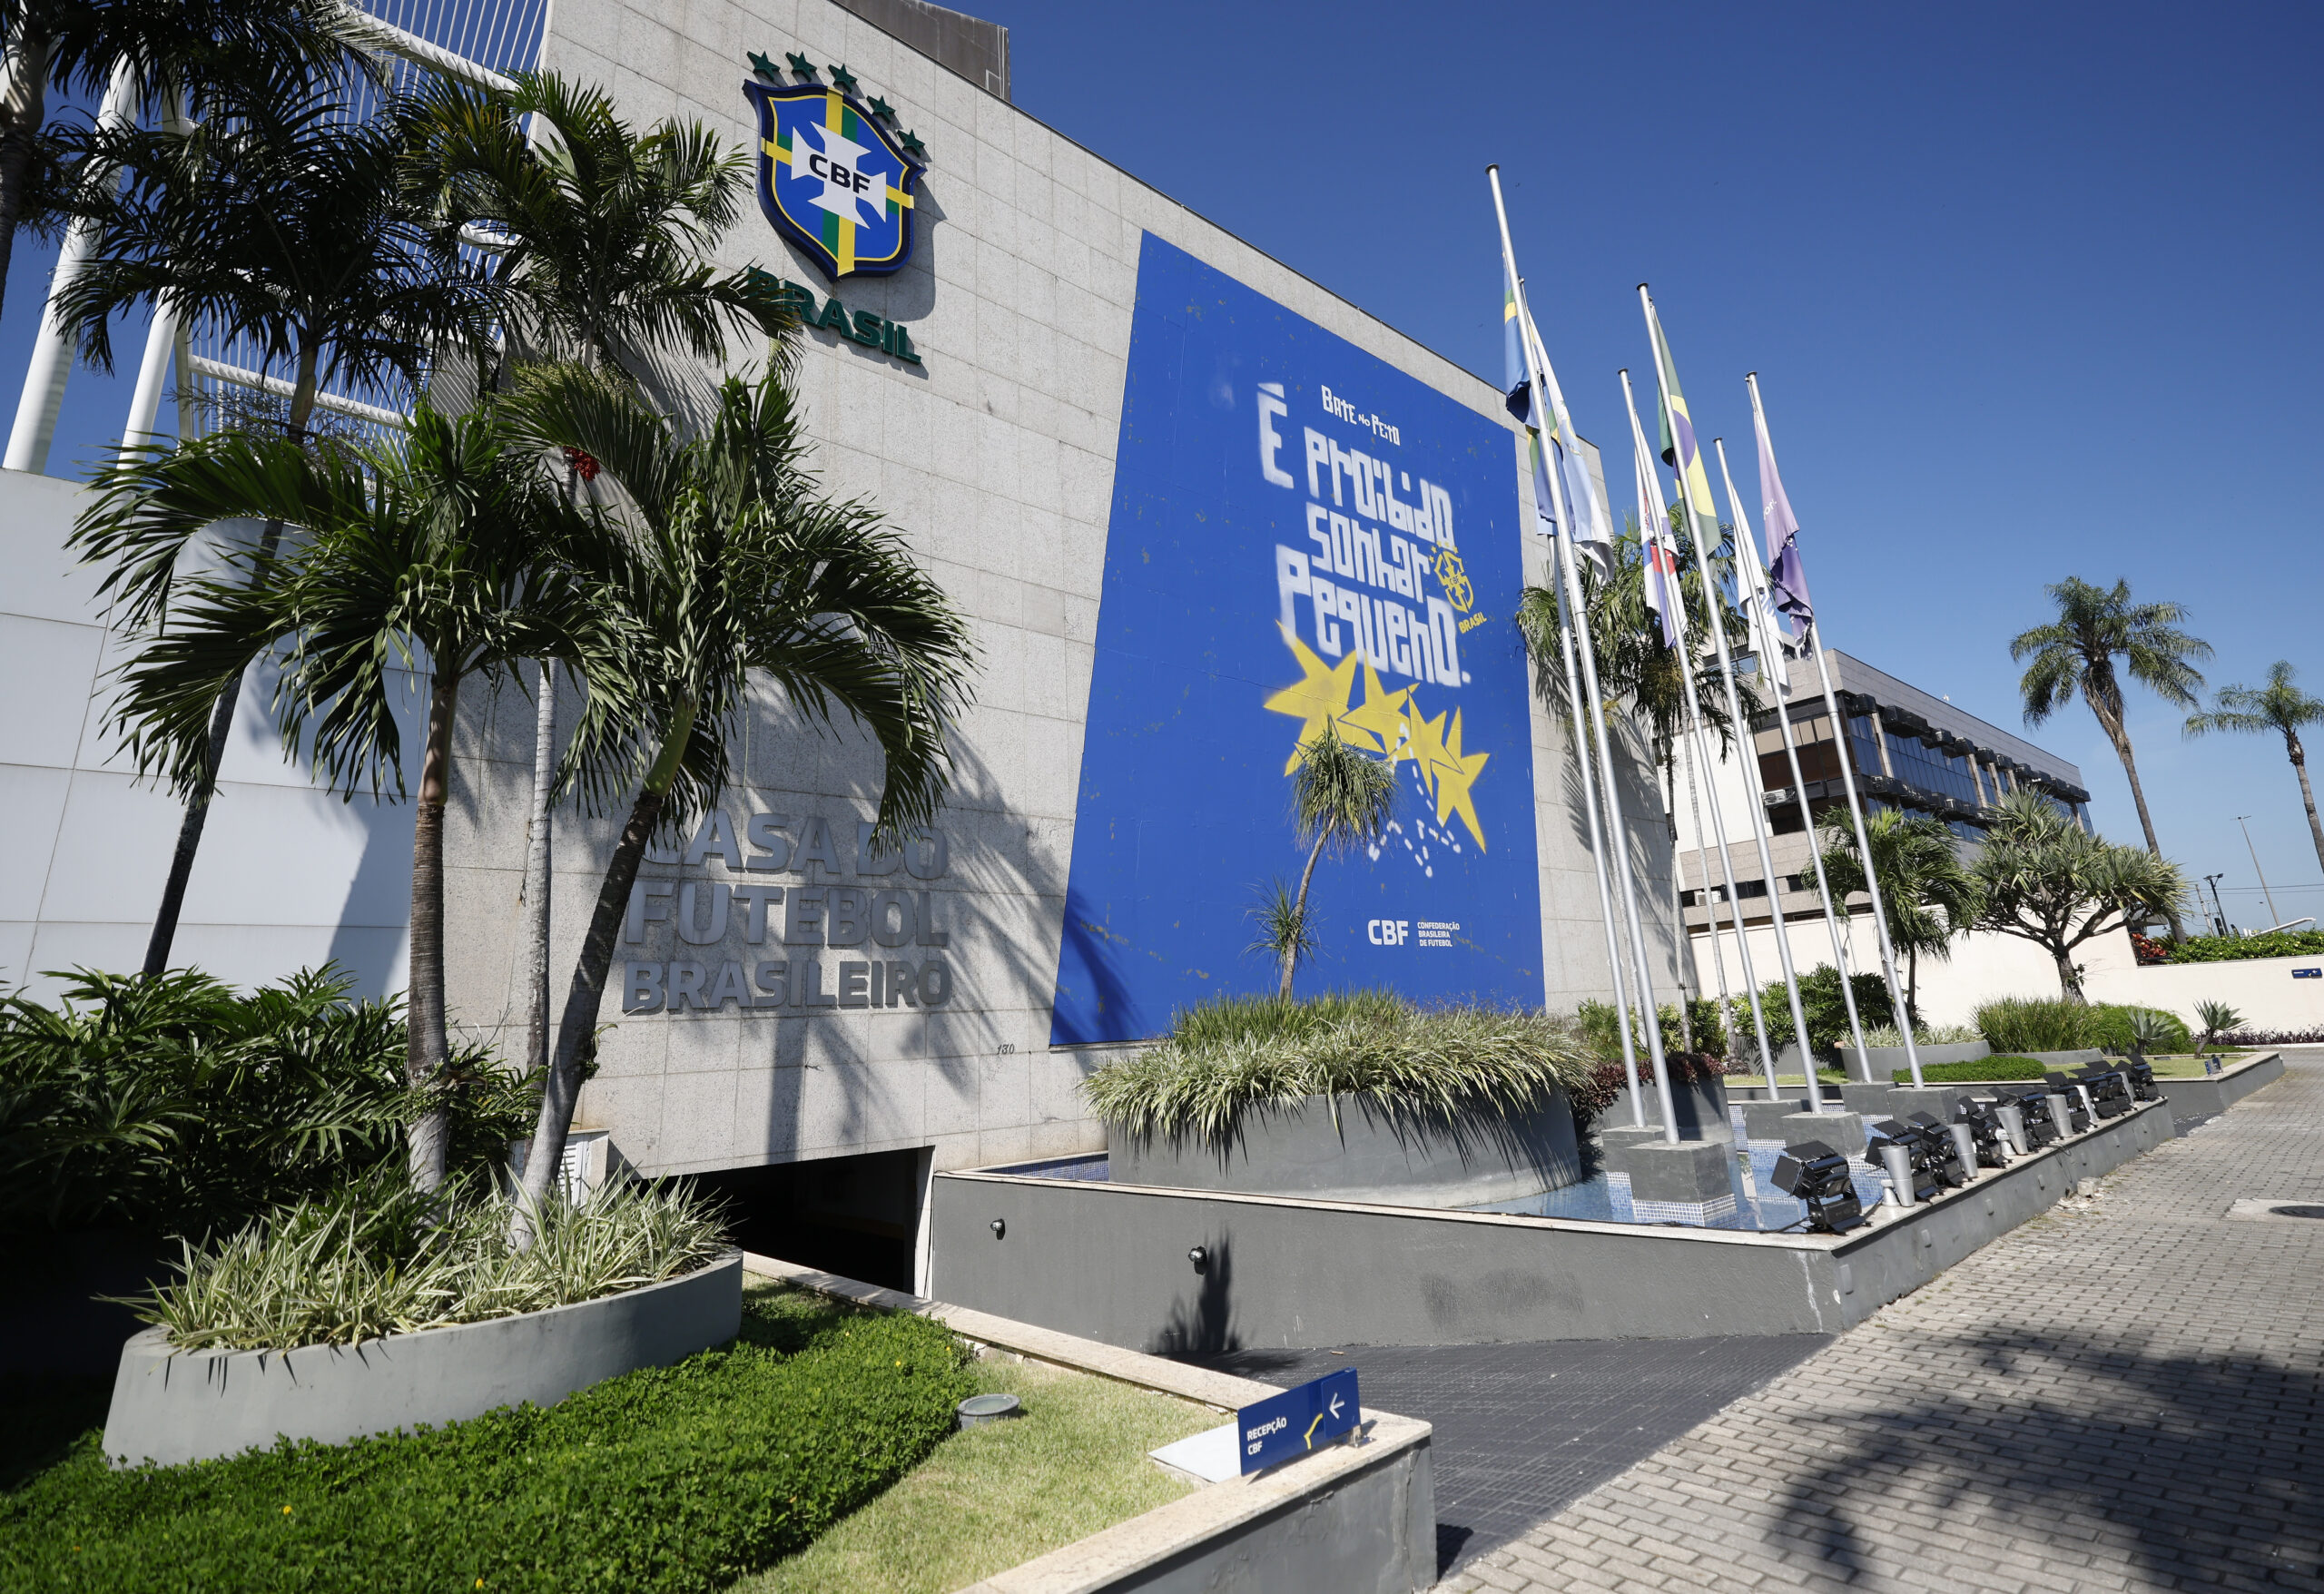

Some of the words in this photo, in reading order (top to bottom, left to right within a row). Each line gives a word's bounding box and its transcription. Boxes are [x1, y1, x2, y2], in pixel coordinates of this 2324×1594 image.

[809, 153, 871, 195] CBF
[1458, 611, 1488, 634] BRASIL
[856, 821, 949, 881] DO
[625, 881, 950, 948] FUTEBOL
[1417, 921, 1461, 932] CONFEDERAÇÃO
[1367, 919, 1409, 946] CBF
[1418, 930, 1451, 939] BRASILEIRA
[1419, 939, 1427, 947] DE
[1428, 939, 1453, 948] FUTEBOL
[622, 959, 953, 1015] BRASILEIRO
[1246, 1416, 1287, 1441] RECEPÇÃO
[1247, 1441, 1263, 1456] CBF
